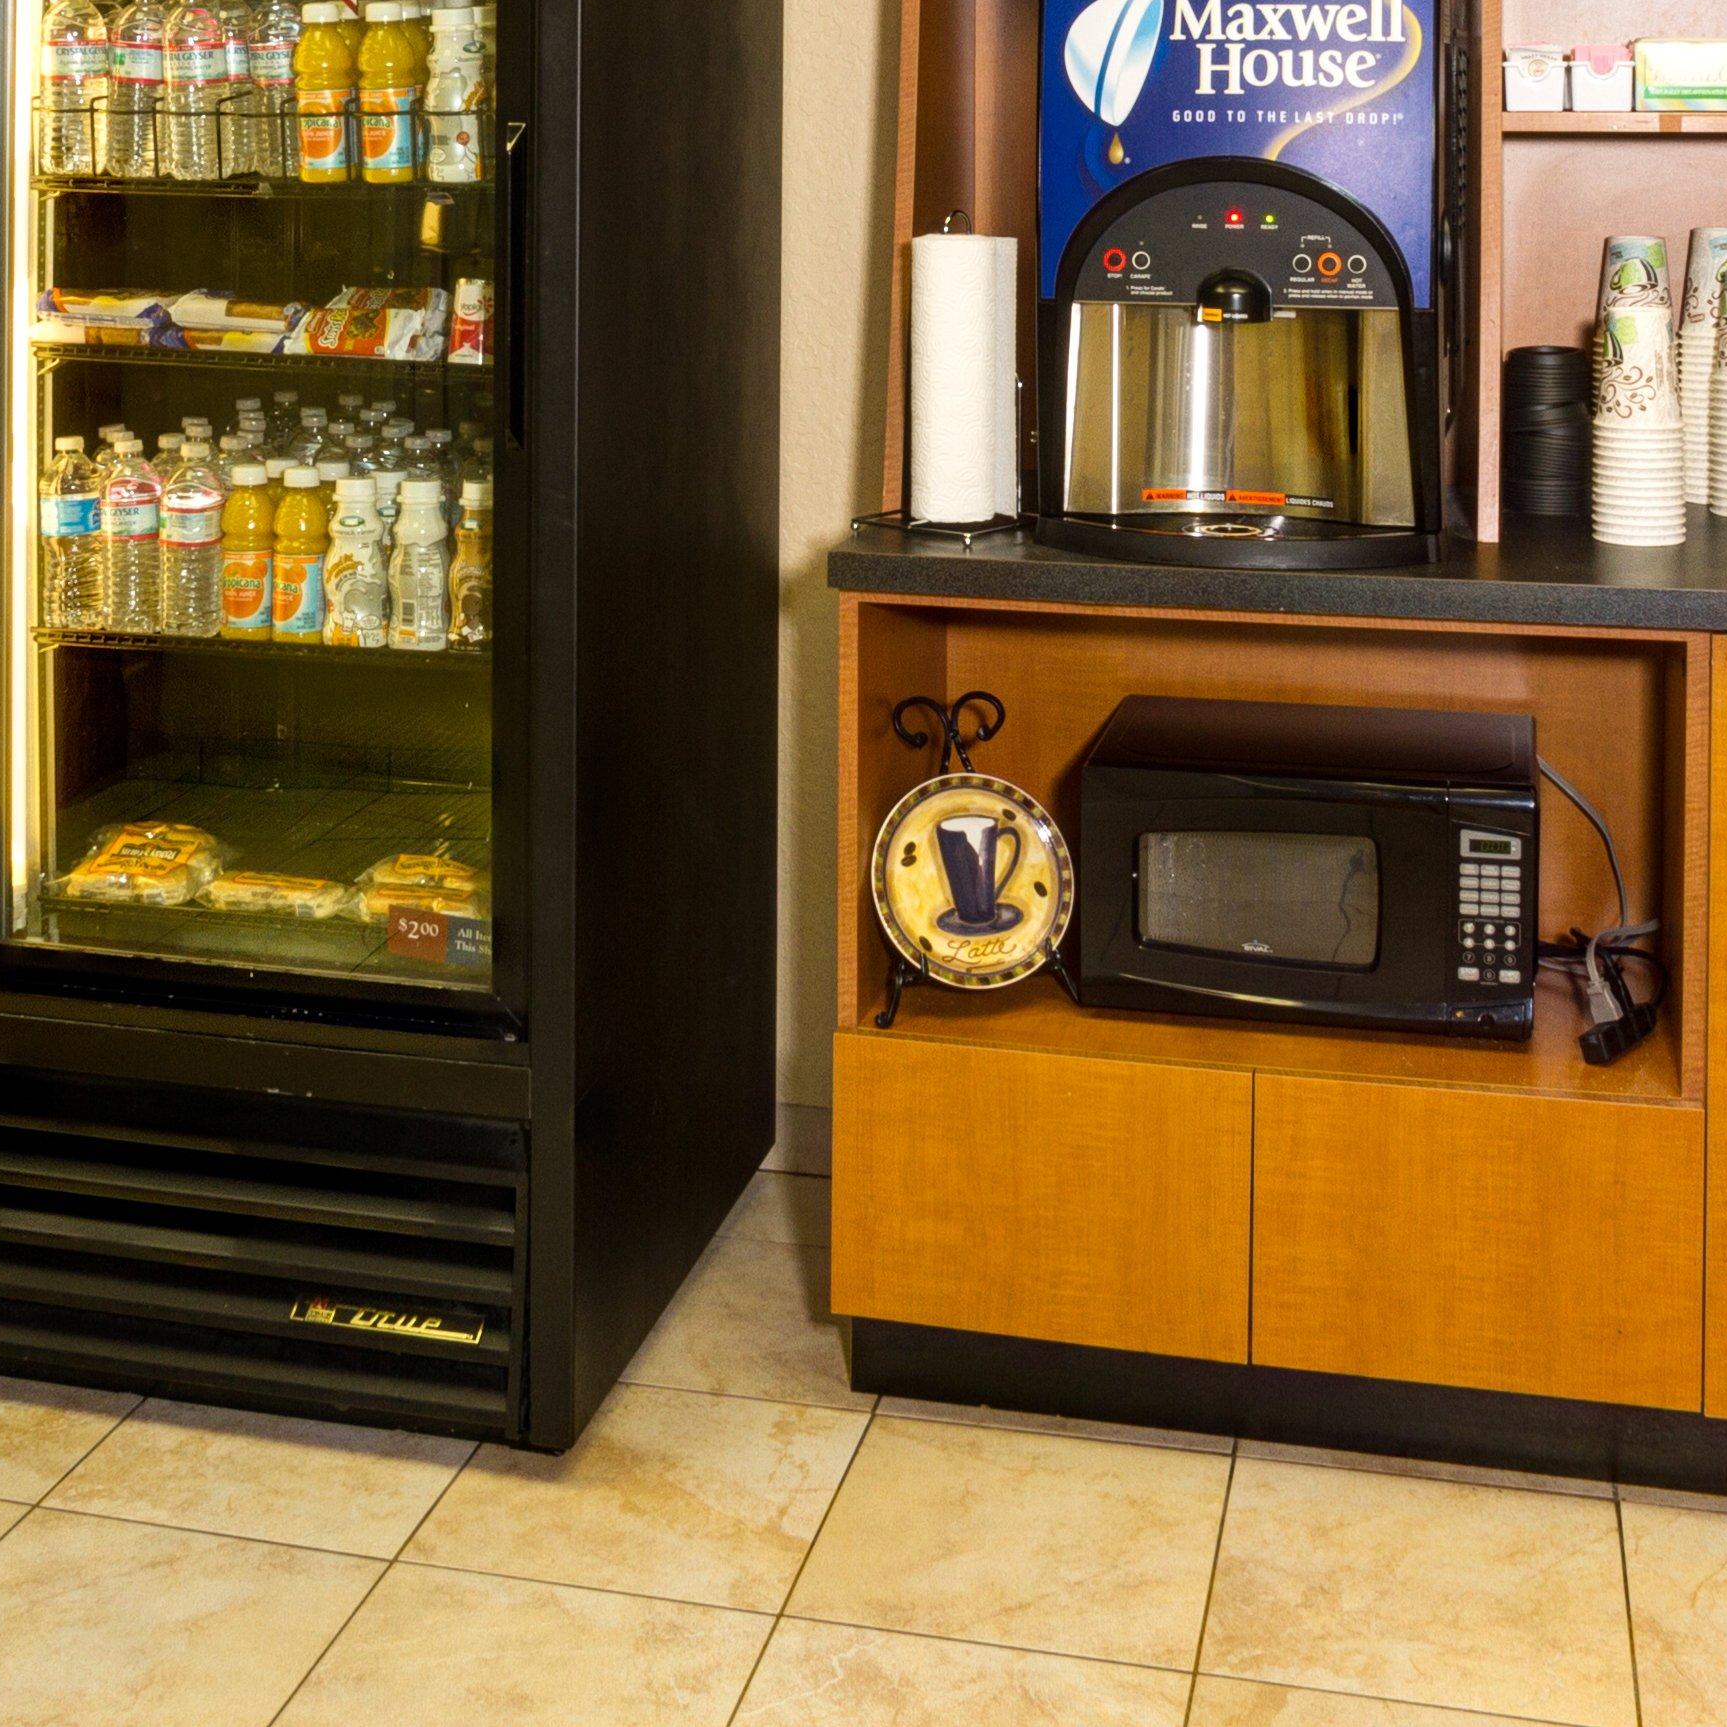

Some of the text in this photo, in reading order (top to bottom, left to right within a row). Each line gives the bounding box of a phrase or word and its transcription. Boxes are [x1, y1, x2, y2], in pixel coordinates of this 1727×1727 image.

[1195, 43, 1377, 96] House
[1172, 109, 1398, 125] GOOD TO THE LAST DROP!
[457, 926, 472, 940] All
[455, 939, 476, 953] This
[942, 936, 1017, 965] Latte
